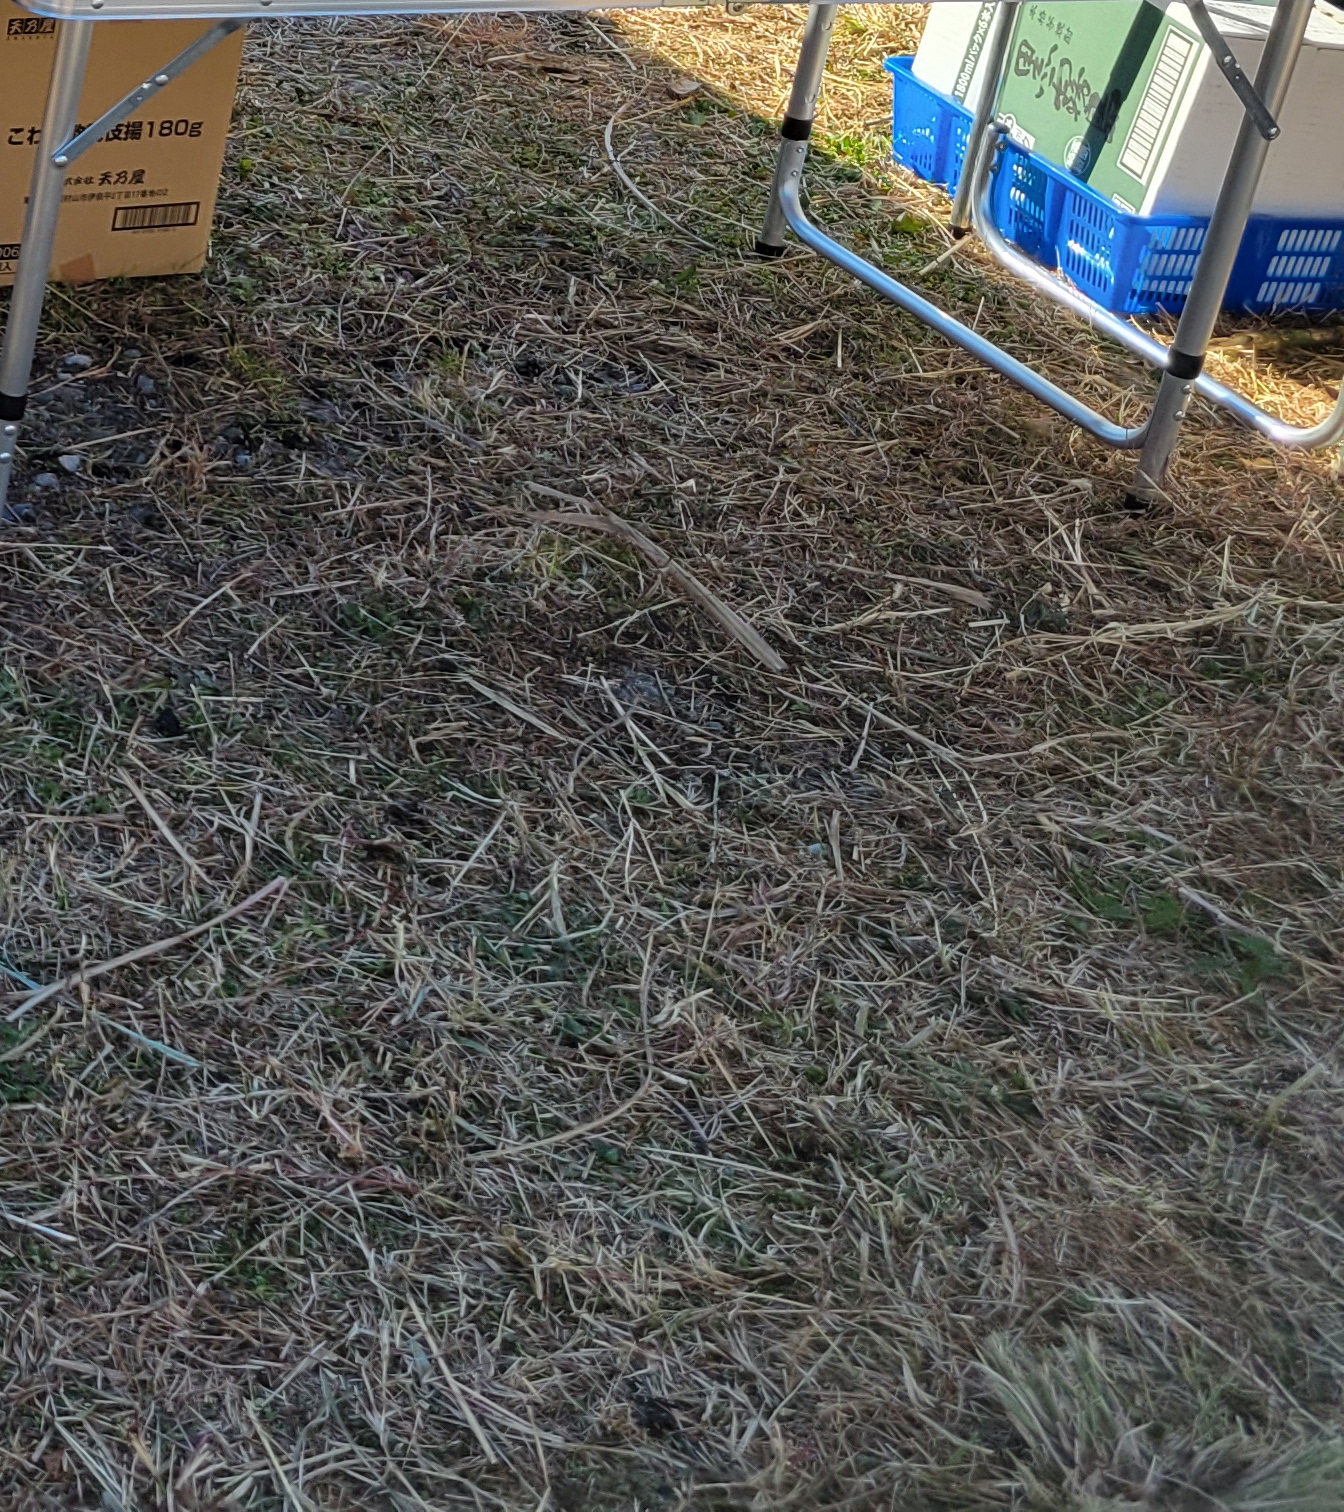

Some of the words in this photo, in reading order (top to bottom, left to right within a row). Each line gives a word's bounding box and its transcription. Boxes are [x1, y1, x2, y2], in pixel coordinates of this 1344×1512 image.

[8, 17, 56, 35] 天乃屋
[97, 168, 147, 187] 天乃屋
